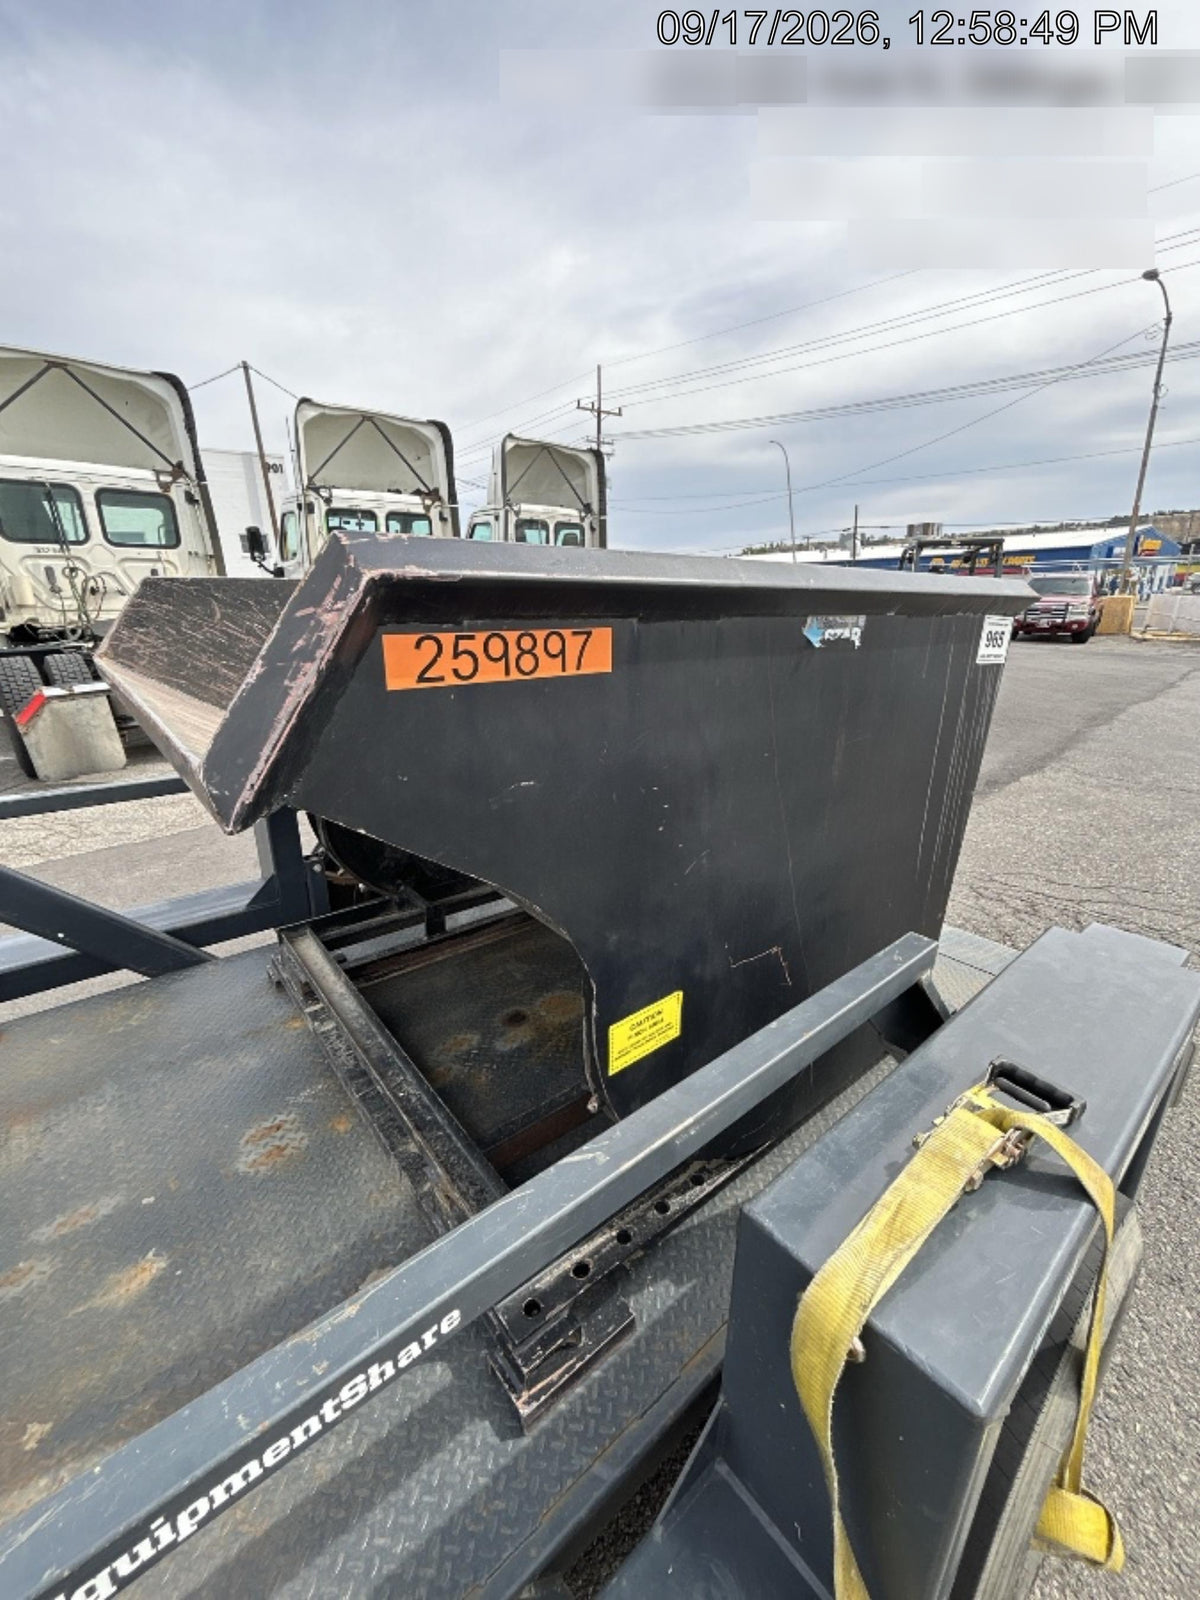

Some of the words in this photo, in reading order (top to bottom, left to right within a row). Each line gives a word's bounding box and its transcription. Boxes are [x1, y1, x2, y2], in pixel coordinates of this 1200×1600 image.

[414, 630, 593, 683] 259897
[985, 630, 1005, 648] 965
[54, 1308, 462, 1600] quipmentShare
